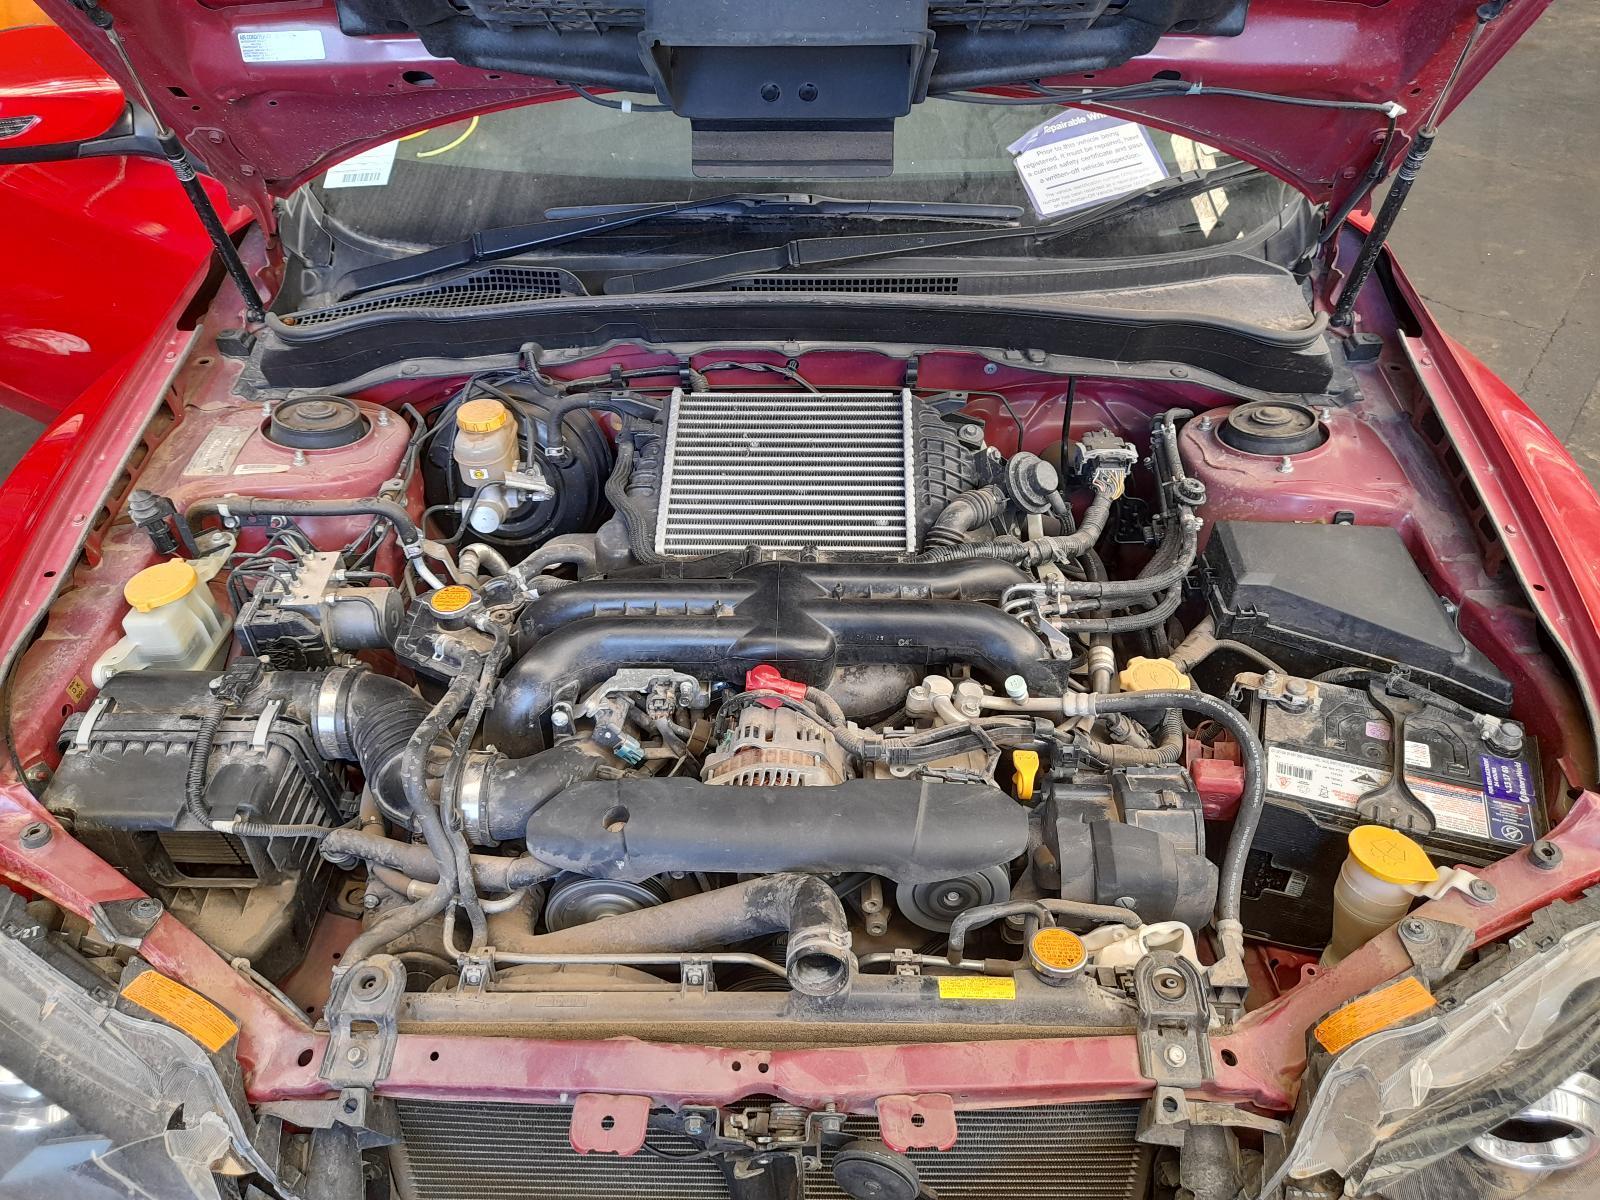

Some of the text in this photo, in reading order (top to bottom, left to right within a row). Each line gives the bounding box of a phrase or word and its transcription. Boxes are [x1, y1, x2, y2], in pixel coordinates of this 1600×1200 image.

[1037, 148, 1053, 156] Prior
[1063, 142, 1076, 150] this
[1078, 136, 1099, 146] vehicle
[1100, 130, 1120, 141] being
[1067, 150, 1082, 158] must
[1124, 134, 1139, 142] have
[1034, 164, 1058, 176] current
[1060, 157, 1080, 170] safety
[1080, 148, 1113, 162] certificate
[1115, 145, 1126, 154] and
[1128, 142, 1144, 152] pass
[1082, 160, 1104, 172] vehicle
